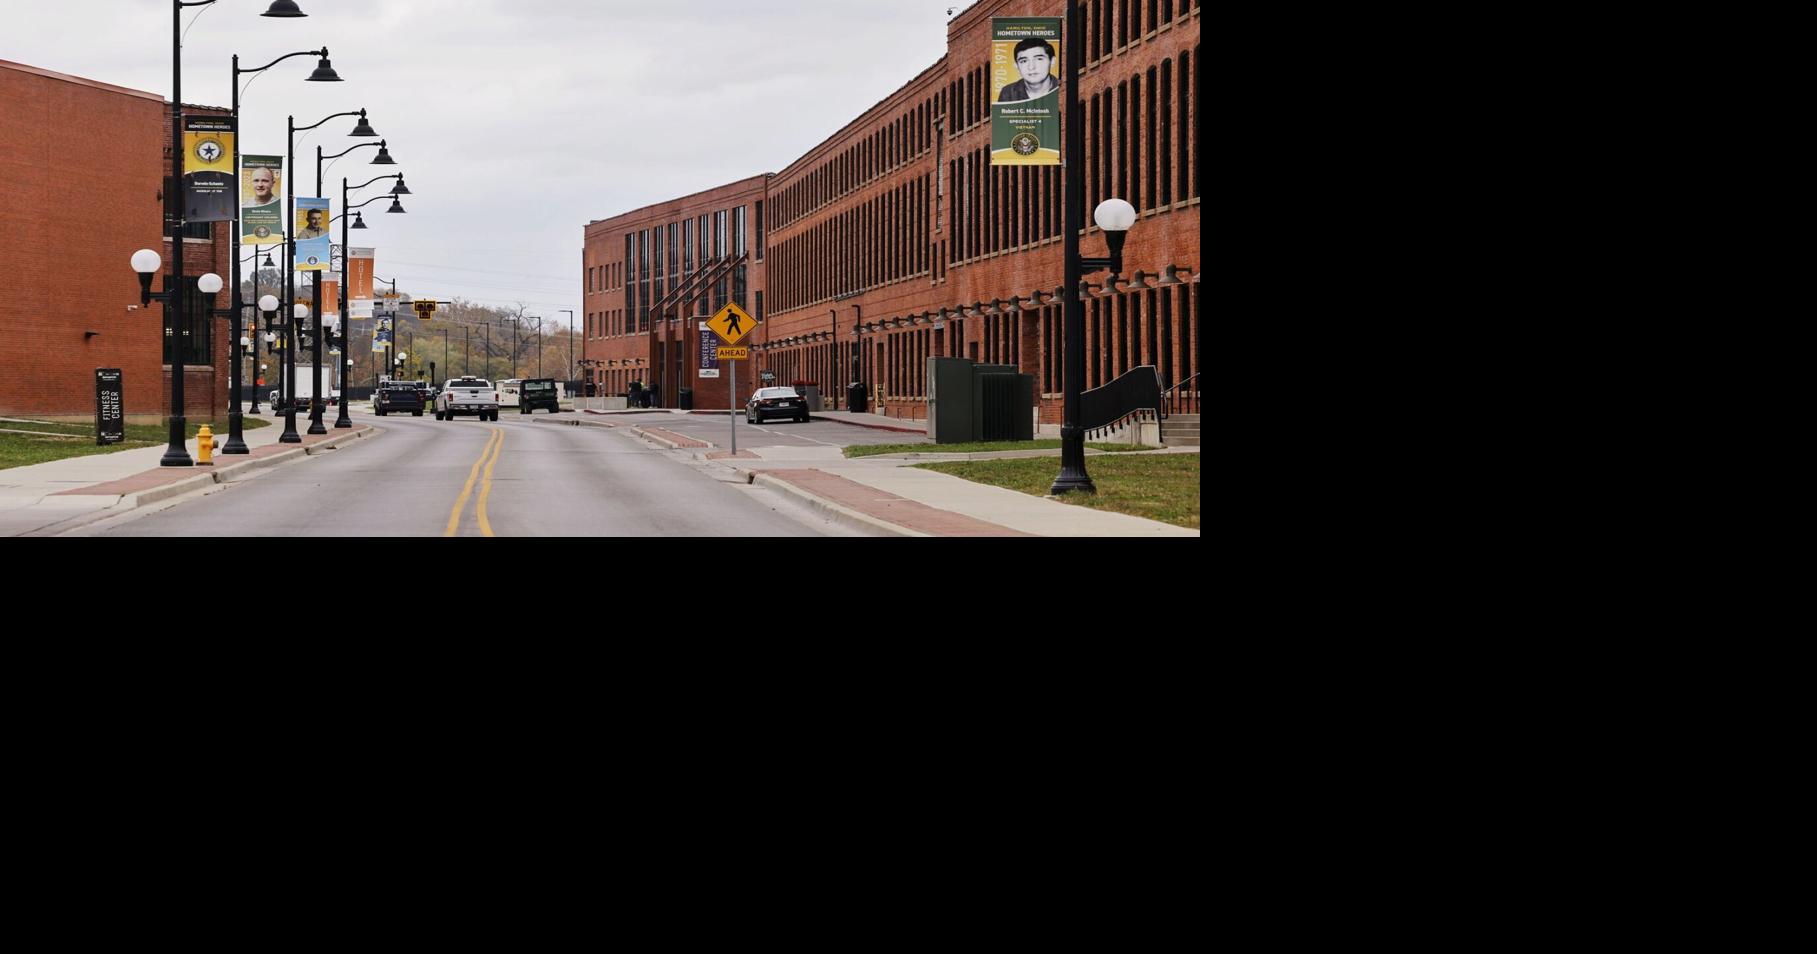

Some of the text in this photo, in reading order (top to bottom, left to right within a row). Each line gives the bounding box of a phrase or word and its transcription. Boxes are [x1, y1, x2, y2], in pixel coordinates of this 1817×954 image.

[702, 332, 710, 368] CONFERENCE
[102, 390, 110, 420] FITNESS
[110, 392, 120, 419] CENTER
